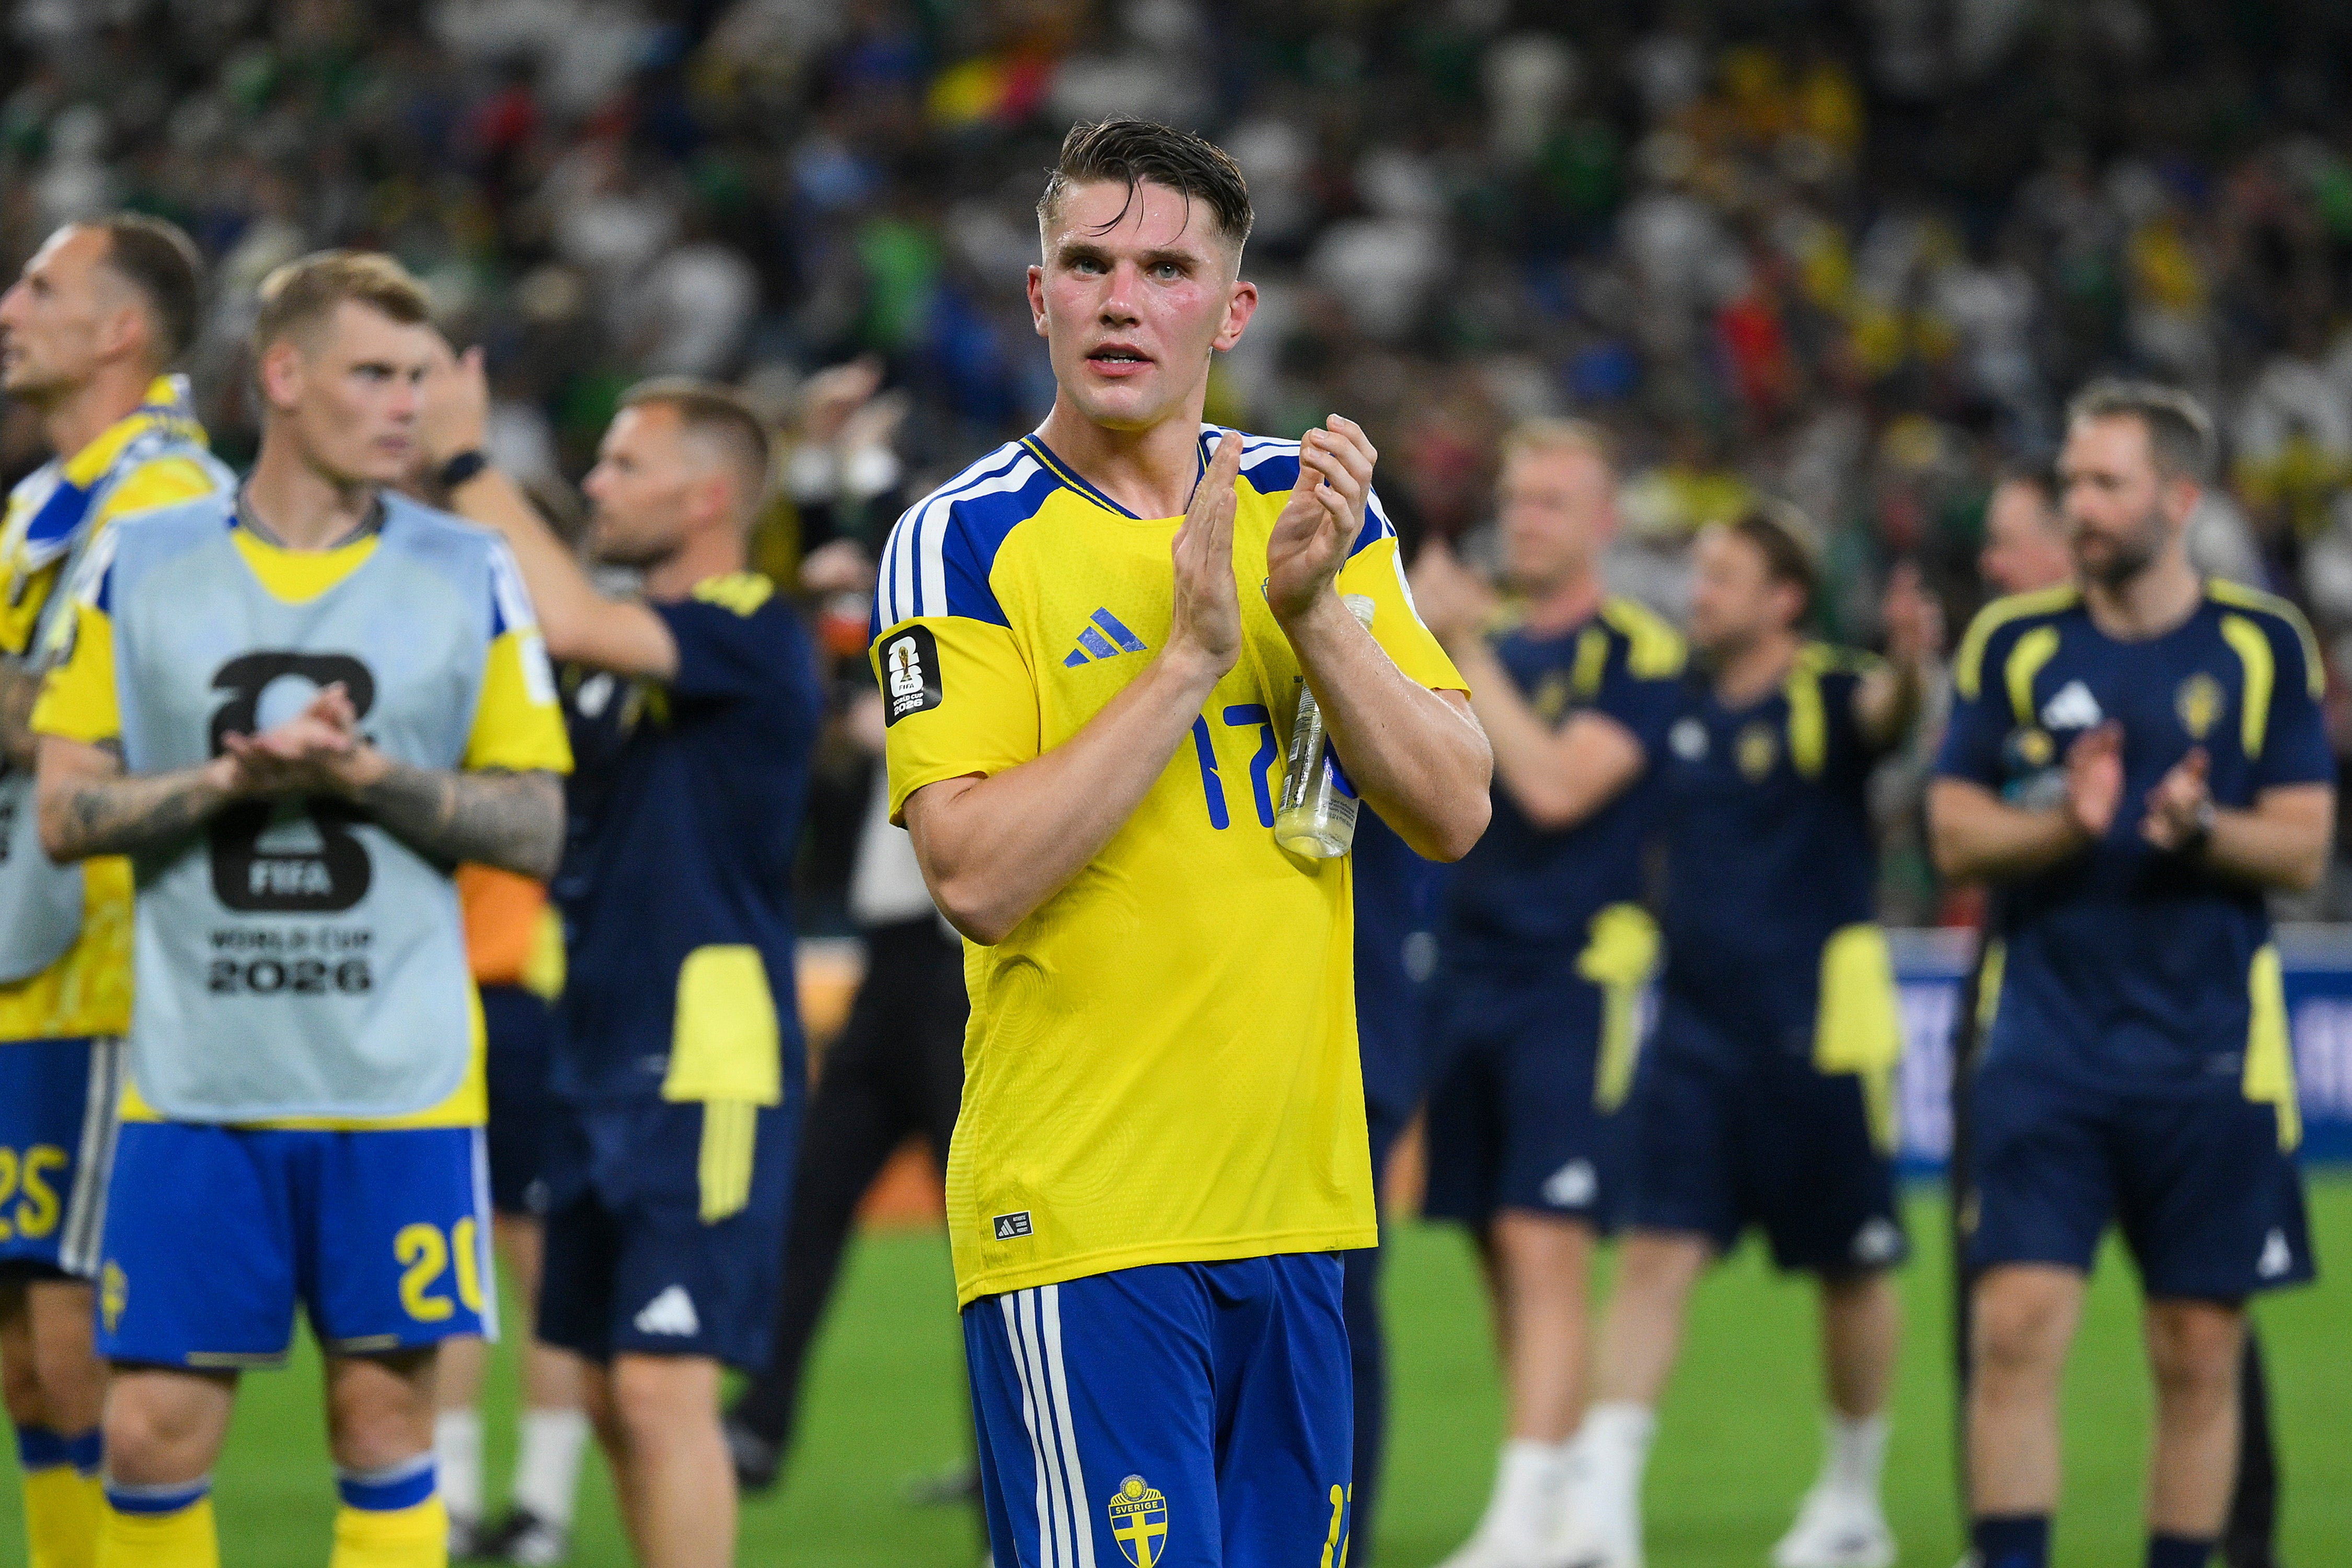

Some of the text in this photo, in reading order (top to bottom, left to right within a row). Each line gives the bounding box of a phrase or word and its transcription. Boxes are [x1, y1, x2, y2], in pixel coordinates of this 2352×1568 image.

[893, 695, 910, 707] WORLD
[894, 698, 923, 716] 2026
[1192, 704, 1278, 830] 17
[207, 958, 373, 994] 2026
[1115, 1501, 1158, 1514] SVERIGE
